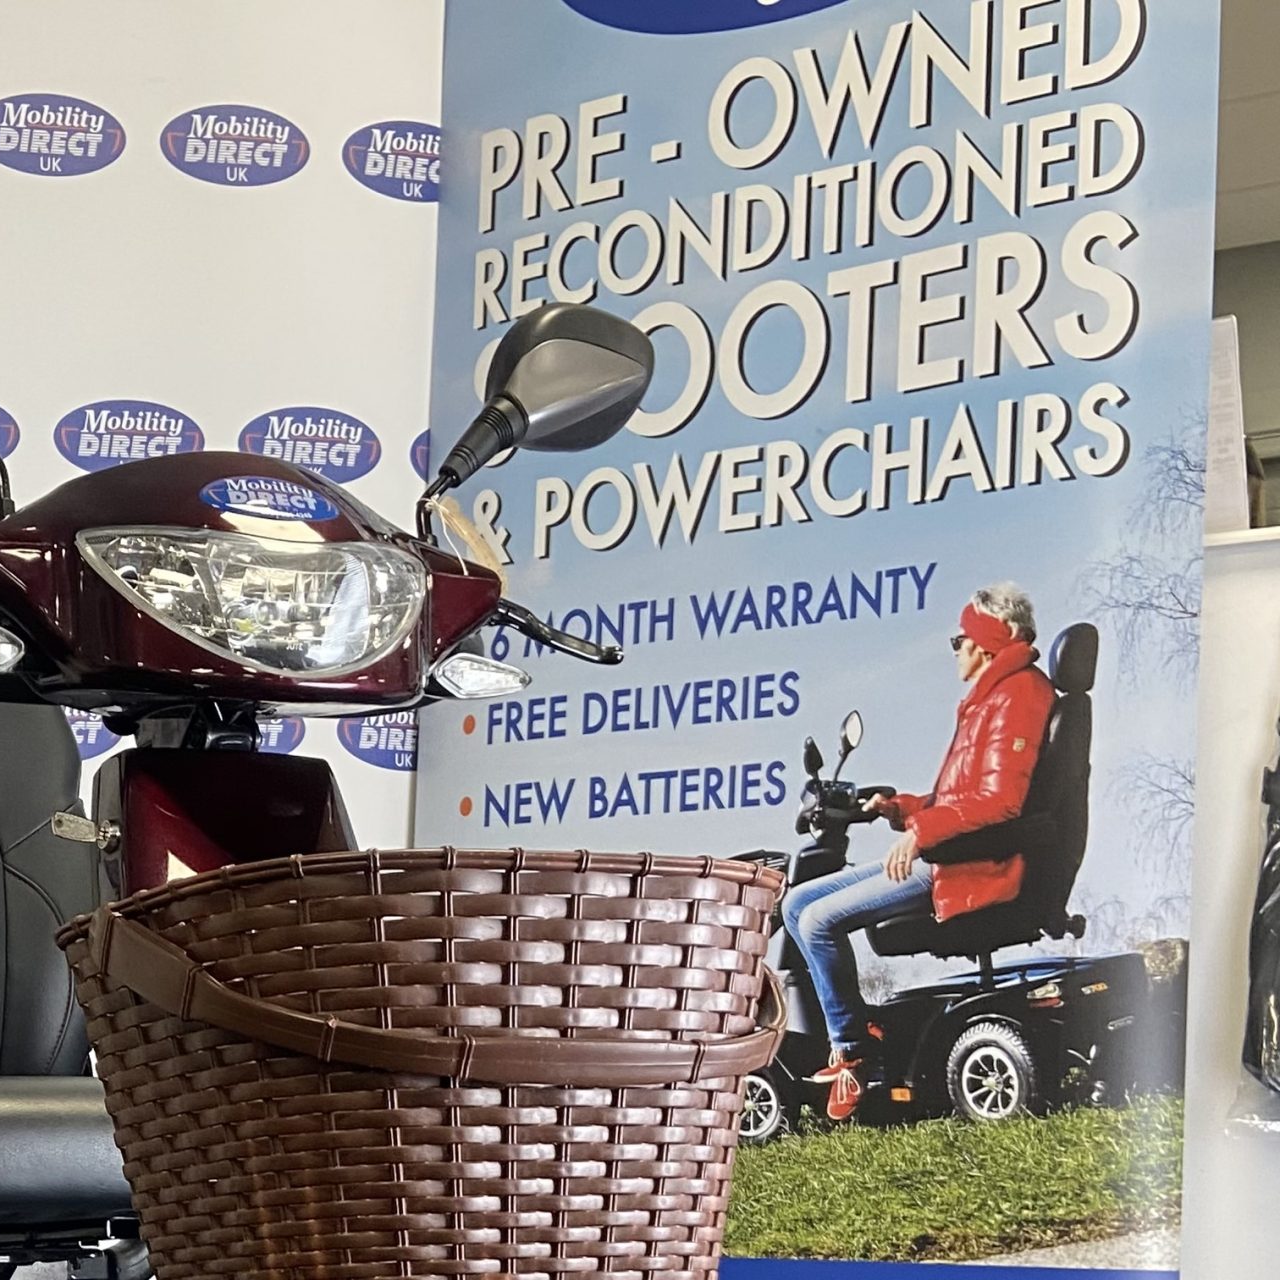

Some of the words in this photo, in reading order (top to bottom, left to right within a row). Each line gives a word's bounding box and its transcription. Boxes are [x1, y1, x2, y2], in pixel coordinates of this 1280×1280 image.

[0, 102, 104, 133] Mobility
[187, 113, 290, 143] Mobility
[479, 93, 627, 234] PRE
[709, 0, 1147, 169] OWNED
[184, 138, 288, 167] DIRECT
[367, 128, 440, 155] Mobili
[39, 157, 62, 172] UK
[226, 167, 248, 182] UK
[364, 152, 440, 184] DIREC
[403, 182, 423, 198] UK
[474, 103, 1146, 329] RECONDITIONED
[474, 210, 1140, 468] OOTERS
[81, 409, 183, 436] Mobility
[265, 415, 363, 444] Mobility
[77, 433, 182, 459] DIRECT
[261, 437, 361, 466] DIRECT
[533, 382, 1130, 558] POWERCHAIRS
[224, 479, 313, 498] Mobility
[228, 490, 317, 510] DIRECT
[491, 625, 510, 662] 6
[689, 562, 938, 640] WARRANTY
[486, 695, 568, 745] FREE
[581, 670, 801, 735] DELIVERIES
[359, 726, 417, 751] DIRE
[395, 753, 413, 767] UK
[483, 777, 576, 828] NEW
[588, 761, 786, 820] BATTERIES
